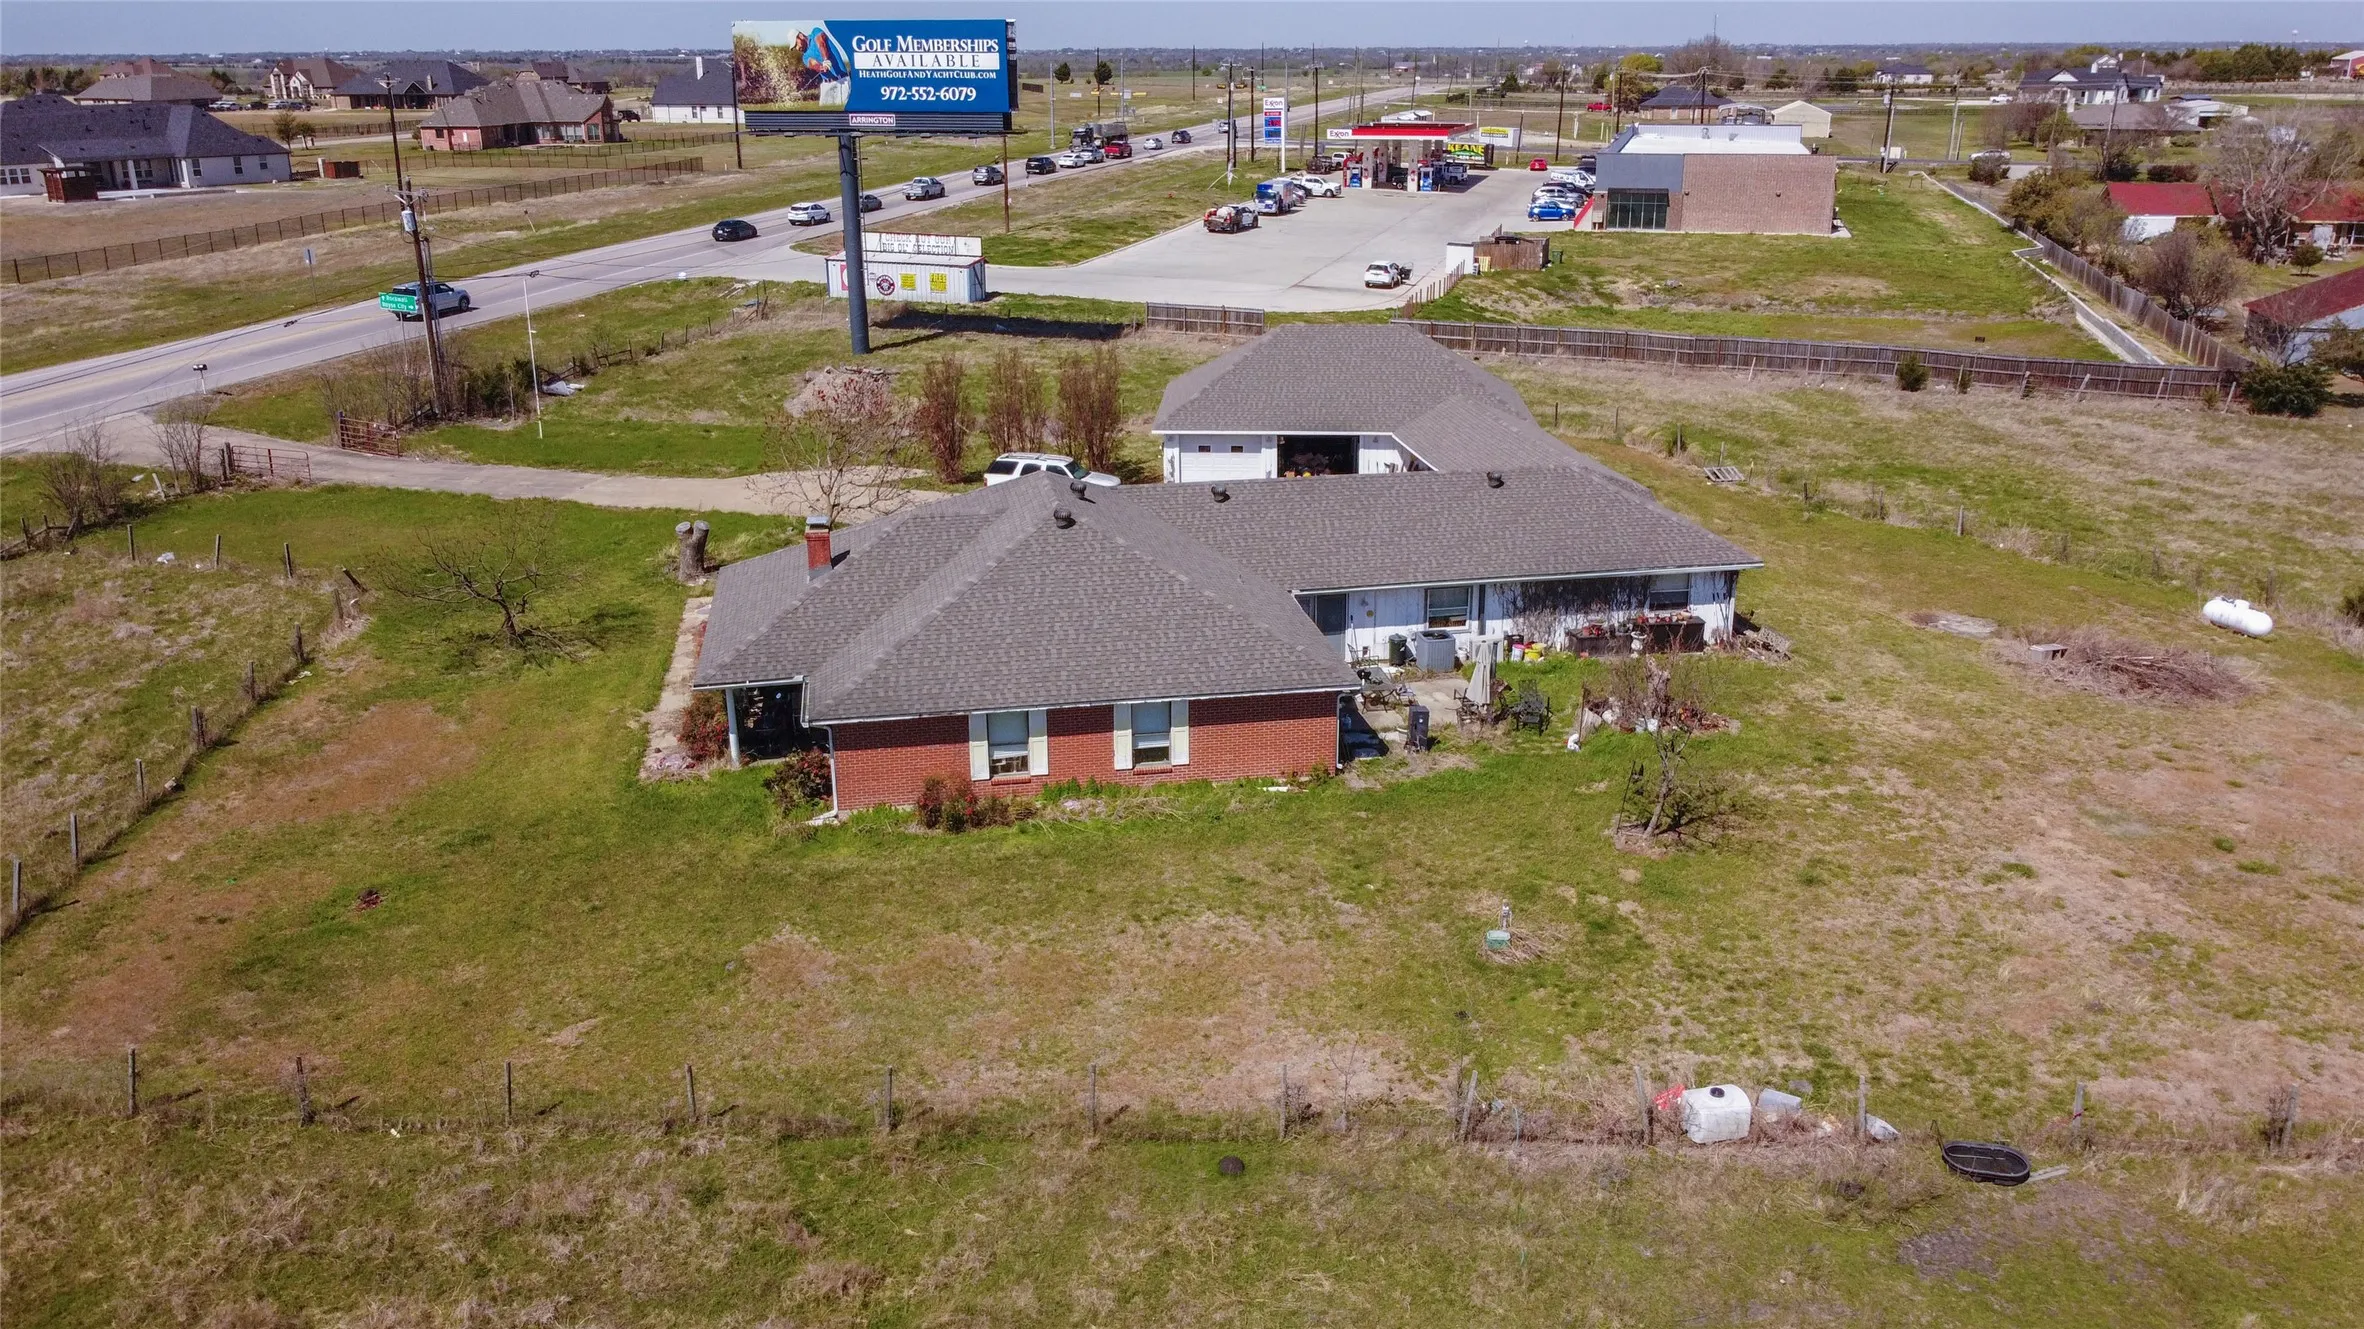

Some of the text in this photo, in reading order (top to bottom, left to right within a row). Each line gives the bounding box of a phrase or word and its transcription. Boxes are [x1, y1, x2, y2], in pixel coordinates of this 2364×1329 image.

[852, 35, 999, 53] GOLF MEMBERSHIPS
[872, 54, 981, 68] AVAILABLE
[880, 86, 977, 101] 972-552-6079
[1264, 99, 1283, 108] Exxon
[851, 116, 894, 124] ARRINGTON
[1329, 130, 1350, 139] Exxon
[1447, 144, 1485, 157] KEANE
[882, 242, 895, 252] BIG
[912, 244, 954, 255] SELECTION
